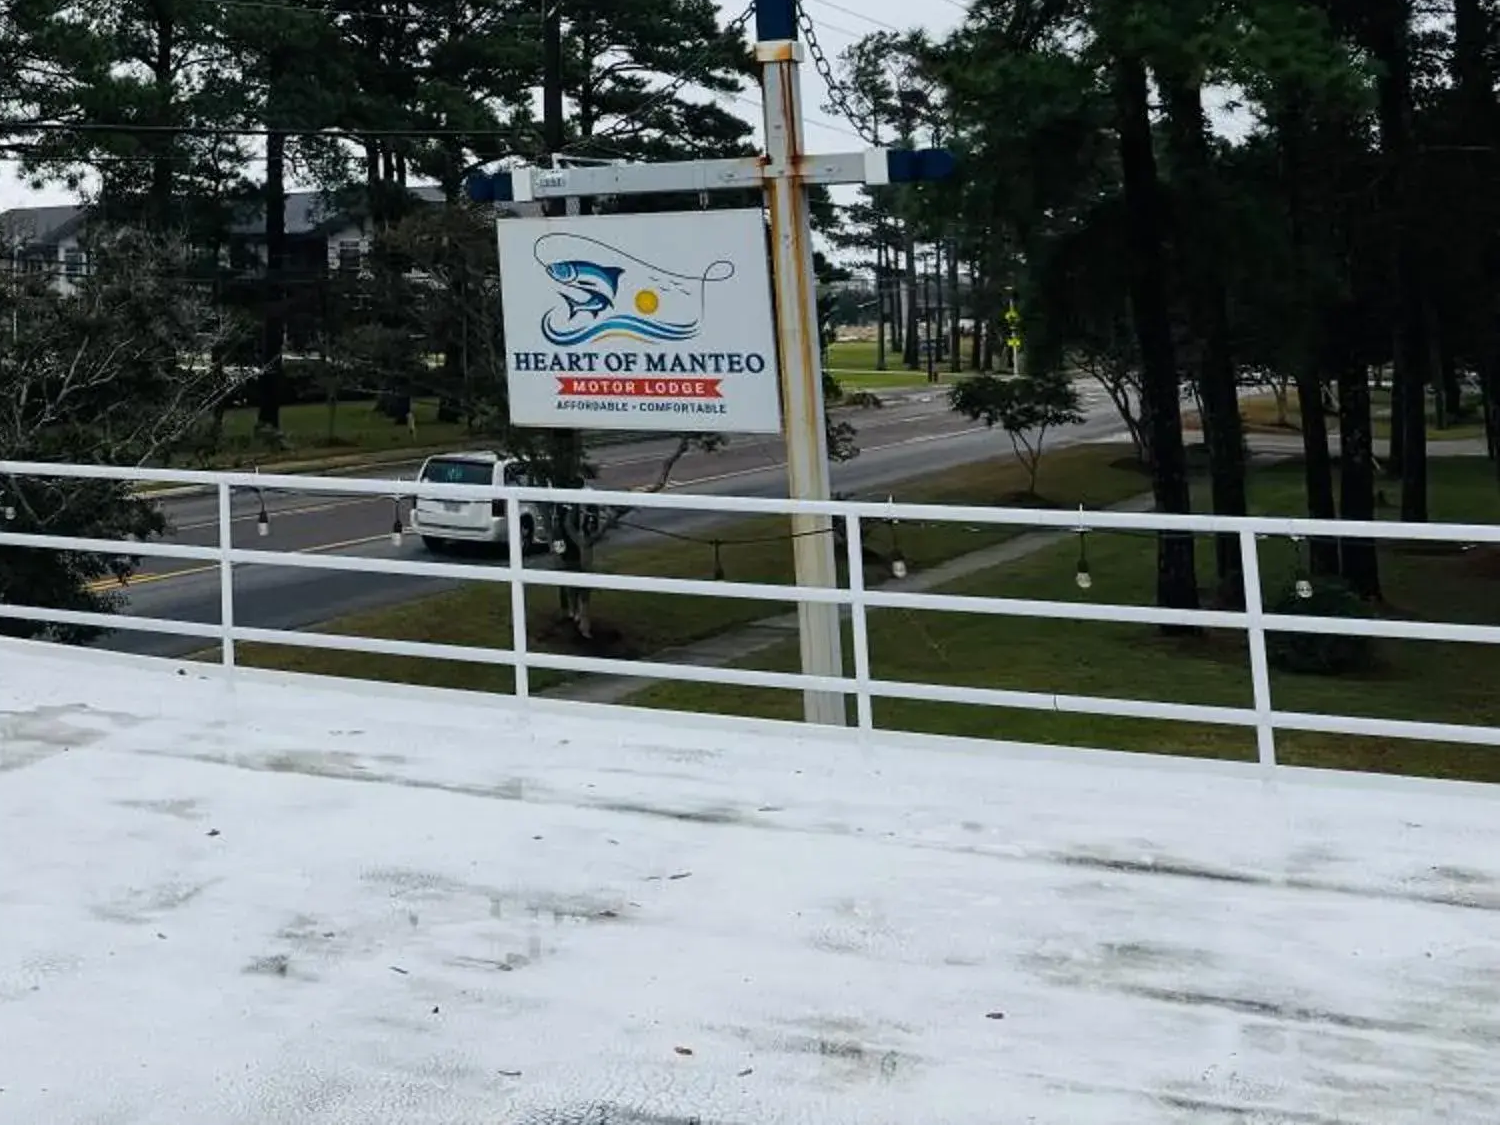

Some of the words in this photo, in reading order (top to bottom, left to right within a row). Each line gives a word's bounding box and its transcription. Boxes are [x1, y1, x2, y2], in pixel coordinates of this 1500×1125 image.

[513, 352, 598, 372] HEART
[604, 352, 638, 372] OF
[645, 353, 766, 374] MANTEO
[573, 380, 636, 394] MOTOR
[645, 382, 706, 395] LODGE
[556, 400, 629, 412] AFFORDABLE
[639, 402, 727, 415] COMFORTABLE
